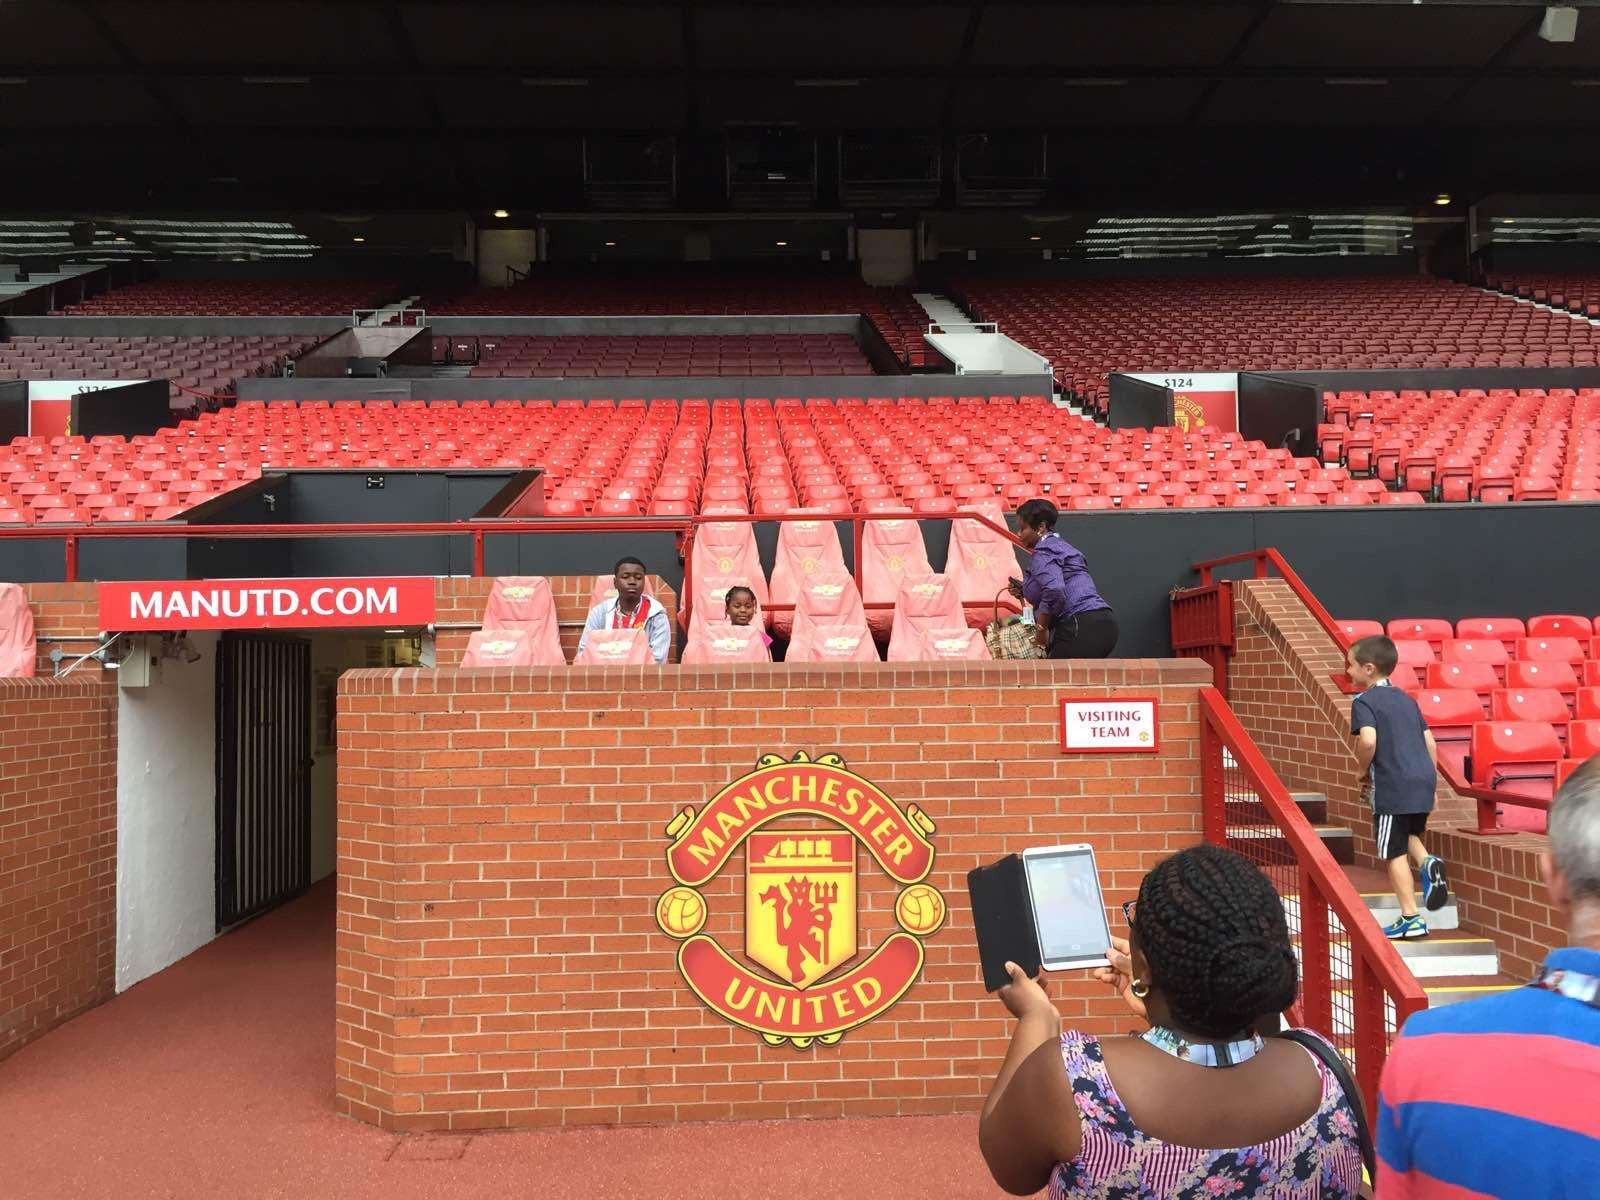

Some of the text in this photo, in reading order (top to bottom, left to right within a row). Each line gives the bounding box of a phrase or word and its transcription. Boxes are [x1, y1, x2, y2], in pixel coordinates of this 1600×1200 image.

[1165, 378, 1193, 388] S124
[129, 587, 398, 619] MANUTD.COM
[1078, 710, 1142, 722] VISITING
[1091, 726, 1130, 738] TEAM
[687, 775, 913, 866] MANCHESTER
[724, 976, 882, 1025] UNITED
